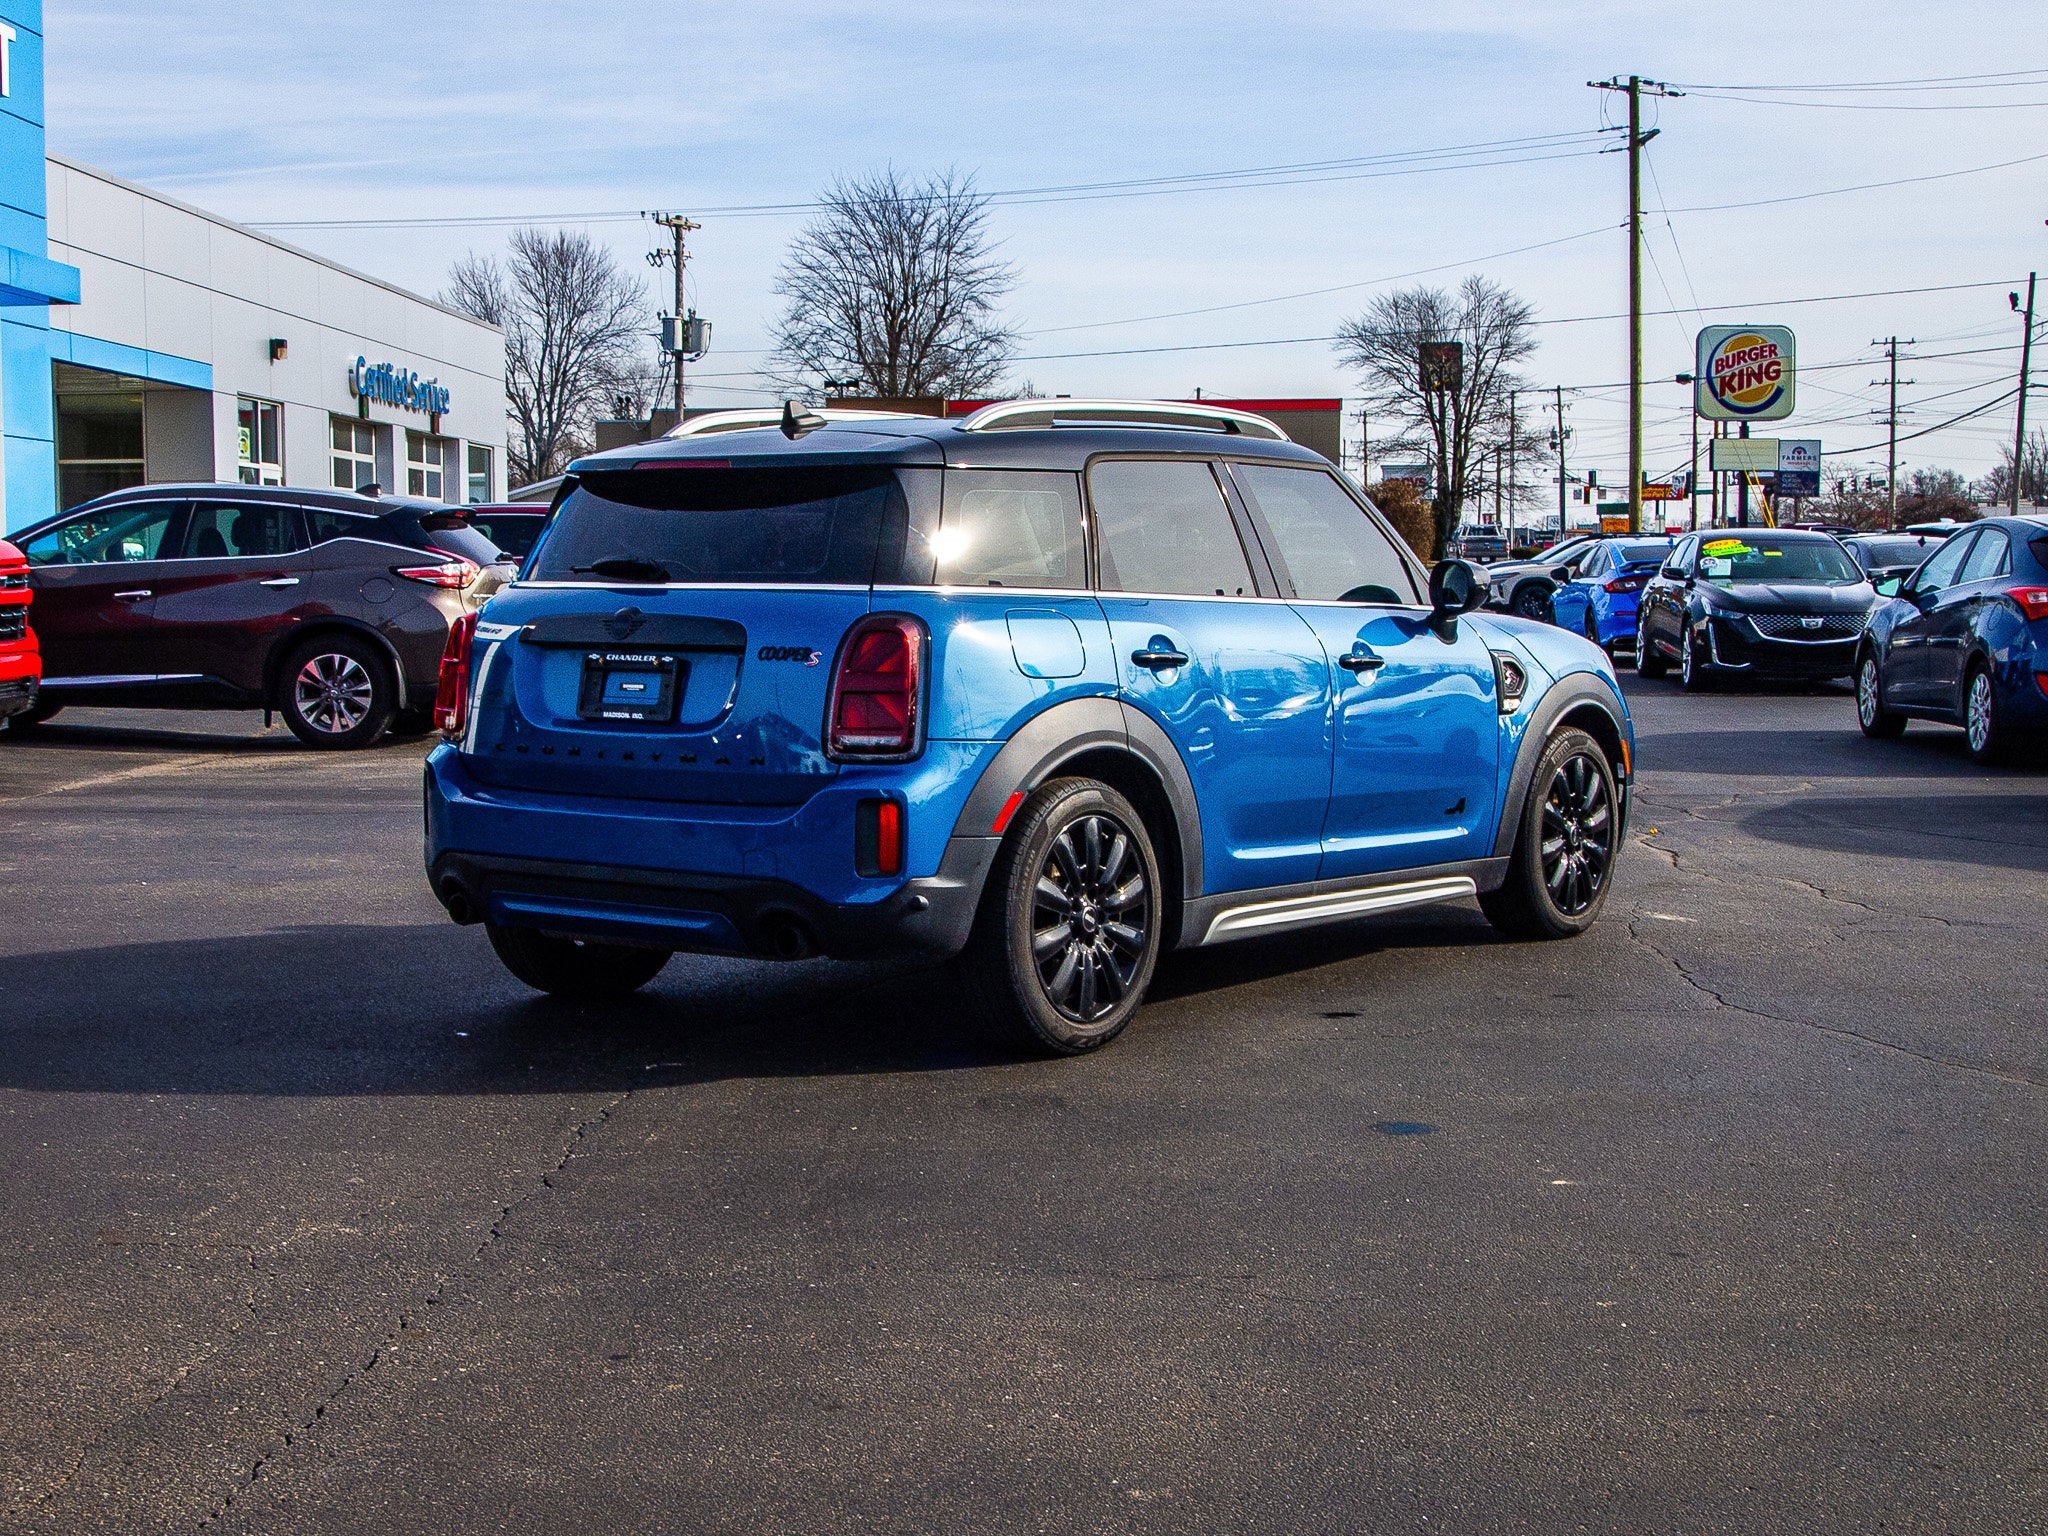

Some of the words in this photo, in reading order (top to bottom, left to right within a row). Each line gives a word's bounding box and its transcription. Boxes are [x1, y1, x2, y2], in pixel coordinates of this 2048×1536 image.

[1714, 343, 1779, 376] BURGER
[356, 355, 408, 406] Certified
[410, 371, 450, 415] Service
[1718, 360, 1781, 398] KING
[606, 653, 657, 662] CHANDLER
[758, 646, 813, 662] COOPER
[804, 651, 823, 667] S
